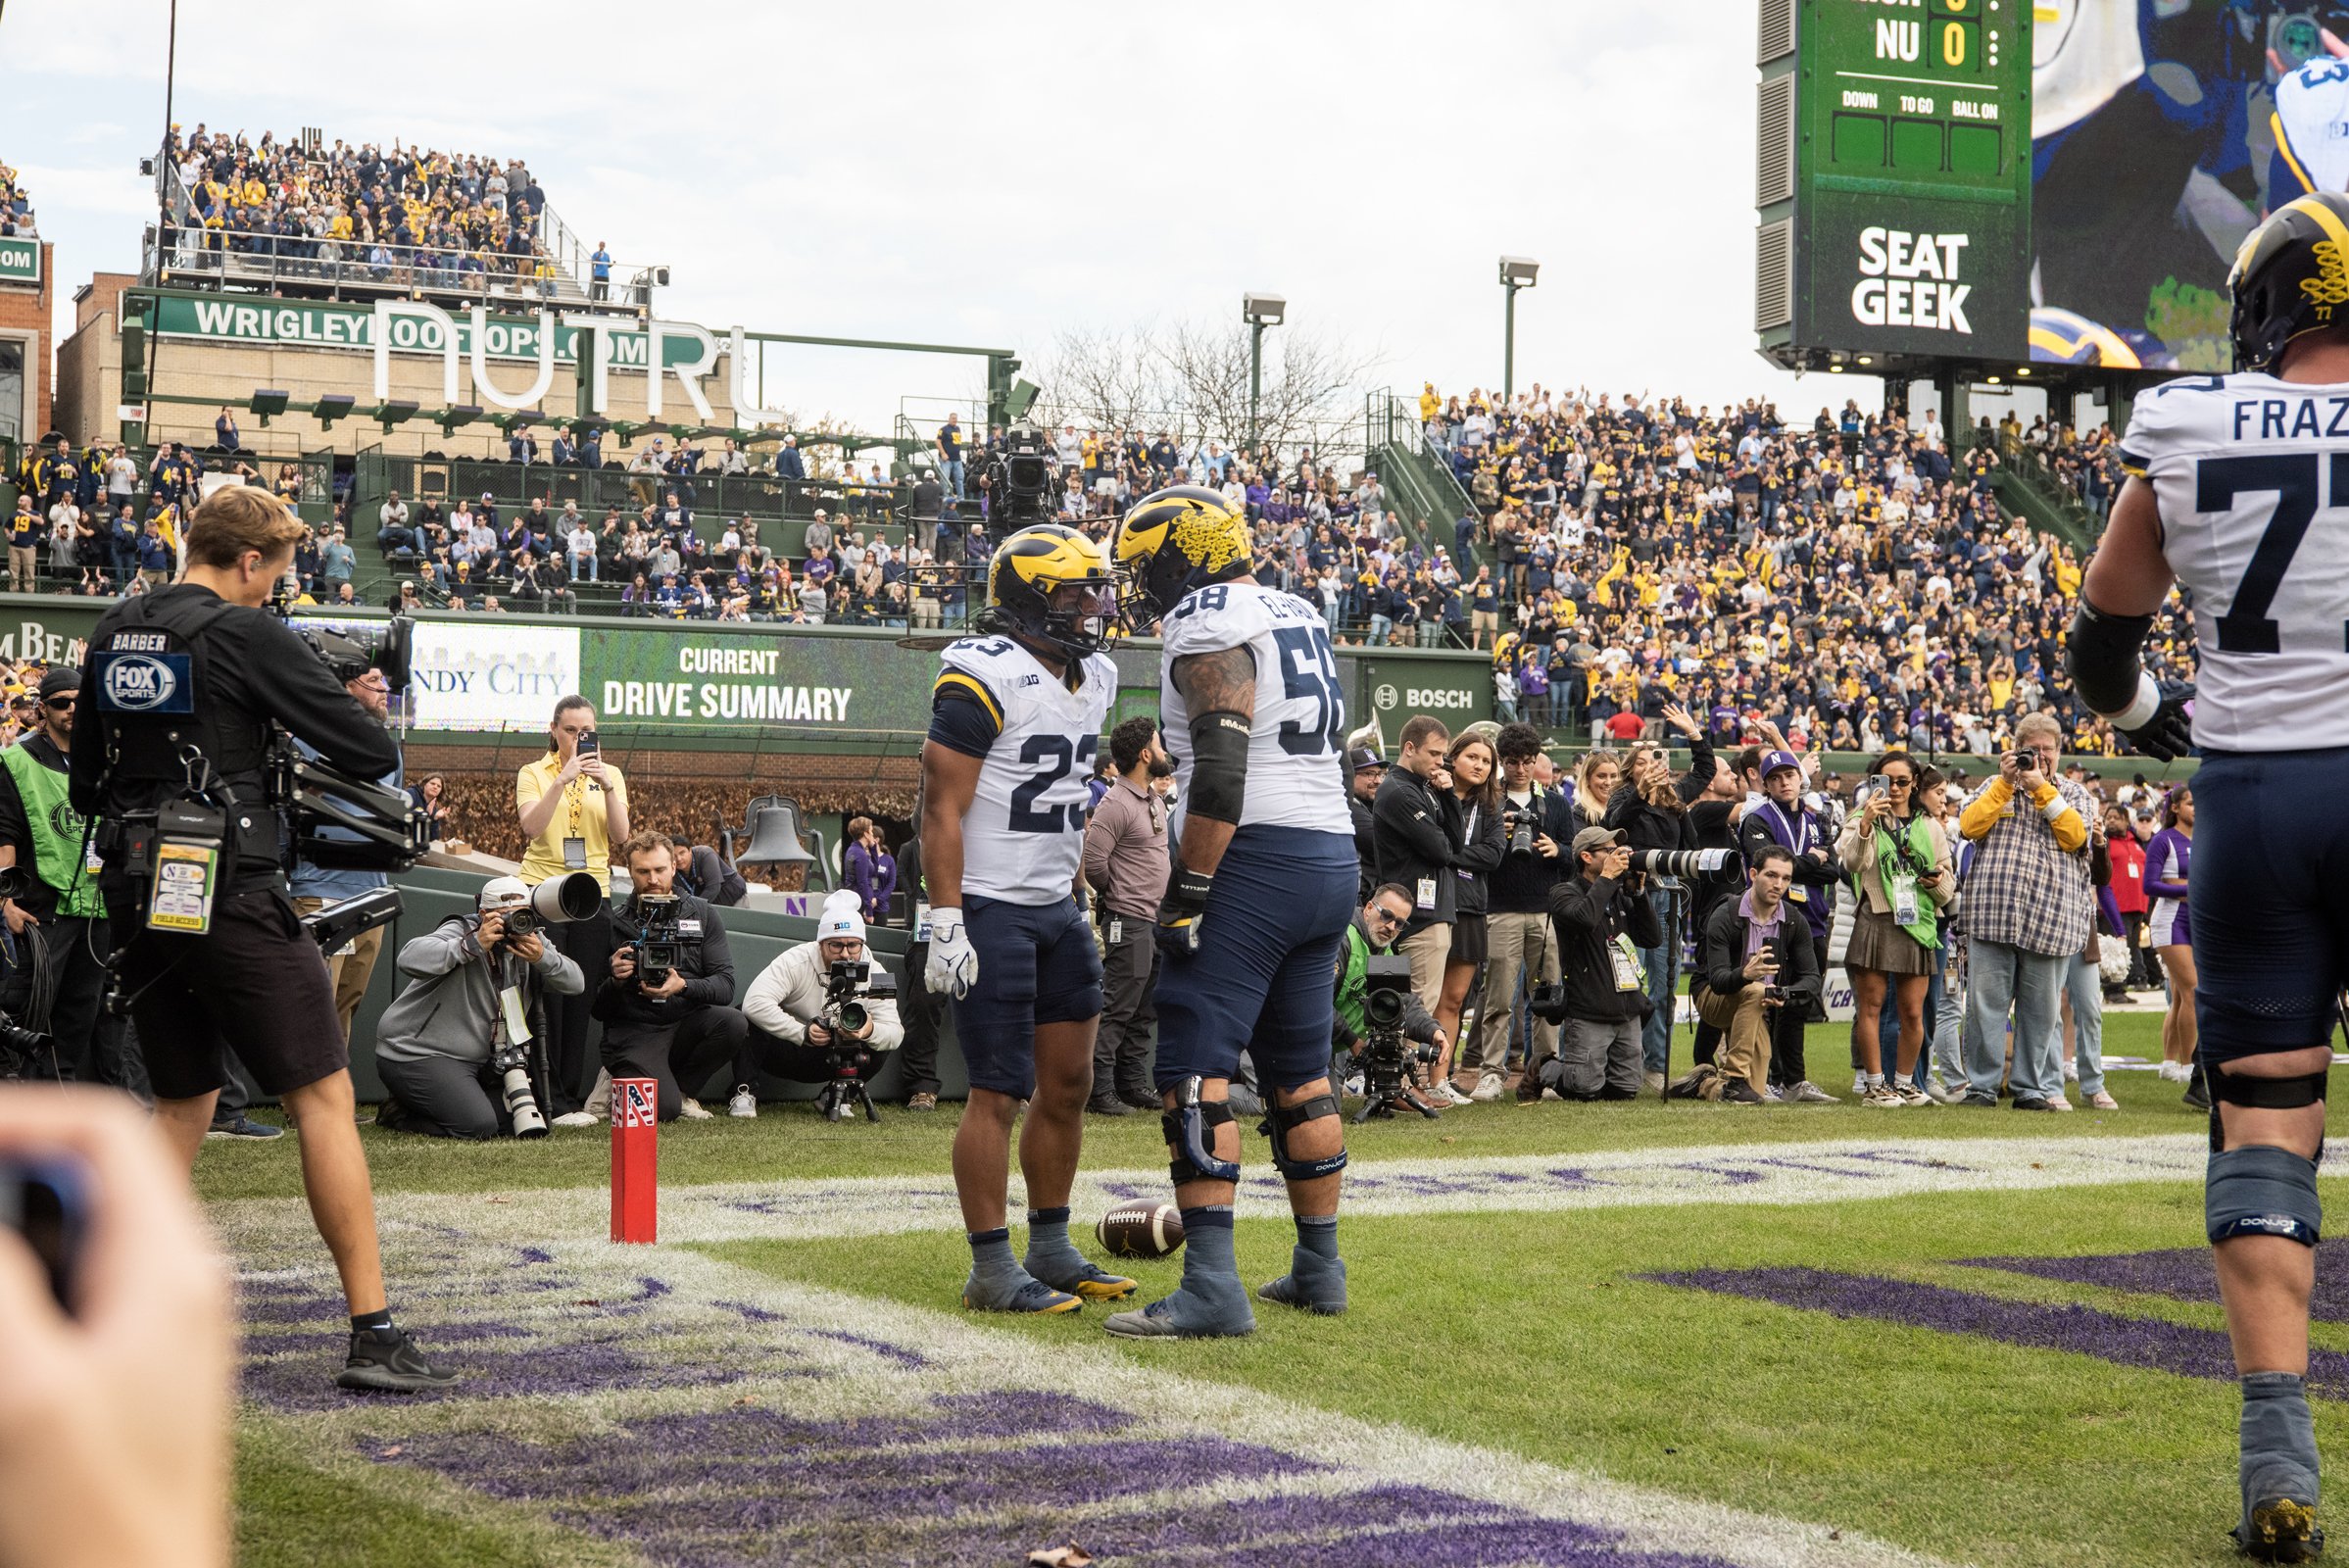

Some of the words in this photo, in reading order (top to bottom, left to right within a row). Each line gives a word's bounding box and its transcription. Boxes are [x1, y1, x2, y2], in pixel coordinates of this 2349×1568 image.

[1876, 19, 1920, 61] NU
[1943, 23, 1965, 66] 0
[1842, 90, 1878, 109] DOWN
[1900, 96, 1917, 113] TO
[1918, 98, 1933, 115] GO
[1952, 100, 1980, 119] BALL
[1982, 104, 1998, 120] ON
[1859, 226, 1969, 280] SEAT
[1851, 278, 1973, 334] GEEK
[2315, 306, 2332, 320] 77
[14, 515, 31, 532] 19
[1568, 527, 1579, 538] M
[1175, 585, 1229, 619] 58
[112, 633, 167, 652] BARBER
[680, 647, 779, 675] CURRENT
[116, 666, 156, 688] FOX
[489, 662, 567, 696] CITY
[116, 688, 157, 698] SPORTS
[604, 681, 692, 717] DRIVE
[700, 683, 852, 721] SUMMARY
[1406, 689, 1473, 709] BOSCH
[1770, 753, 1782, 764] N
[1008, 734, 1099, 833] 23
[65, 807, 86, 825] FO
[1808, 823, 1820, 836] N
[786, 897, 807, 917] N
[156, 914, 175, 924] FIELD
[627, 1083, 655, 1127] N
[1315, 1157, 1346, 1171] DONJOY
